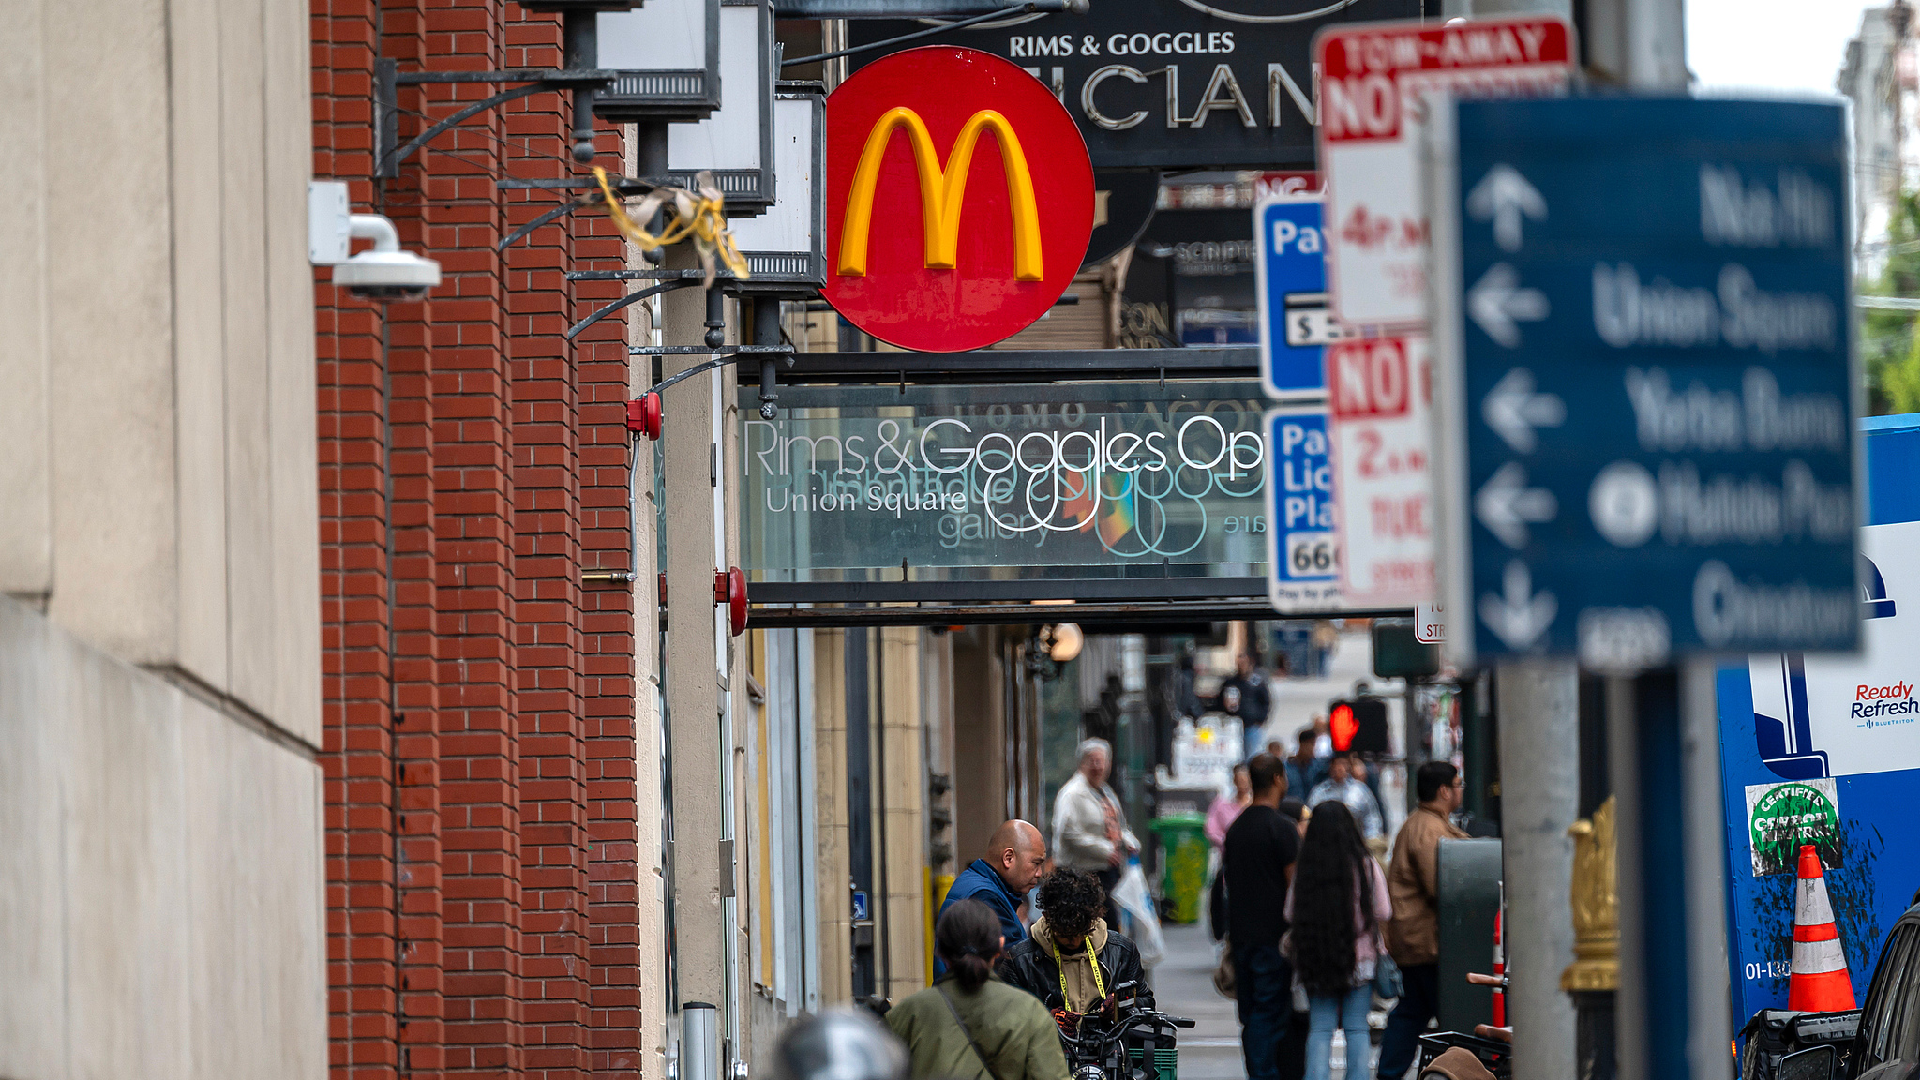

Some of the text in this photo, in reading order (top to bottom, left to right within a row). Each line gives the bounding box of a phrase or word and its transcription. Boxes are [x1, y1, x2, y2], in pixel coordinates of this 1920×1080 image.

[1010, 31, 1236, 57] RIMS & GOGGLES
[1343, 26, 1544, 72] TOW-AWAY
[1022, 62, 1322, 130] ICIAN
[1327, 76, 1394, 136] NO
[1338, 345, 1402, 411] NO
[744, 420, 867, 476] Rims
[874, 419, 917, 474] &
[920, 416, 1166, 532] Goggles
[1177, 415, 1267, 481] Op
[766, 486, 967, 519] Union Square
[938, 504, 1053, 548] gallery
[1851, 696, 1920, 719] Refresh
[1856, 680, 1914, 701] Ready
